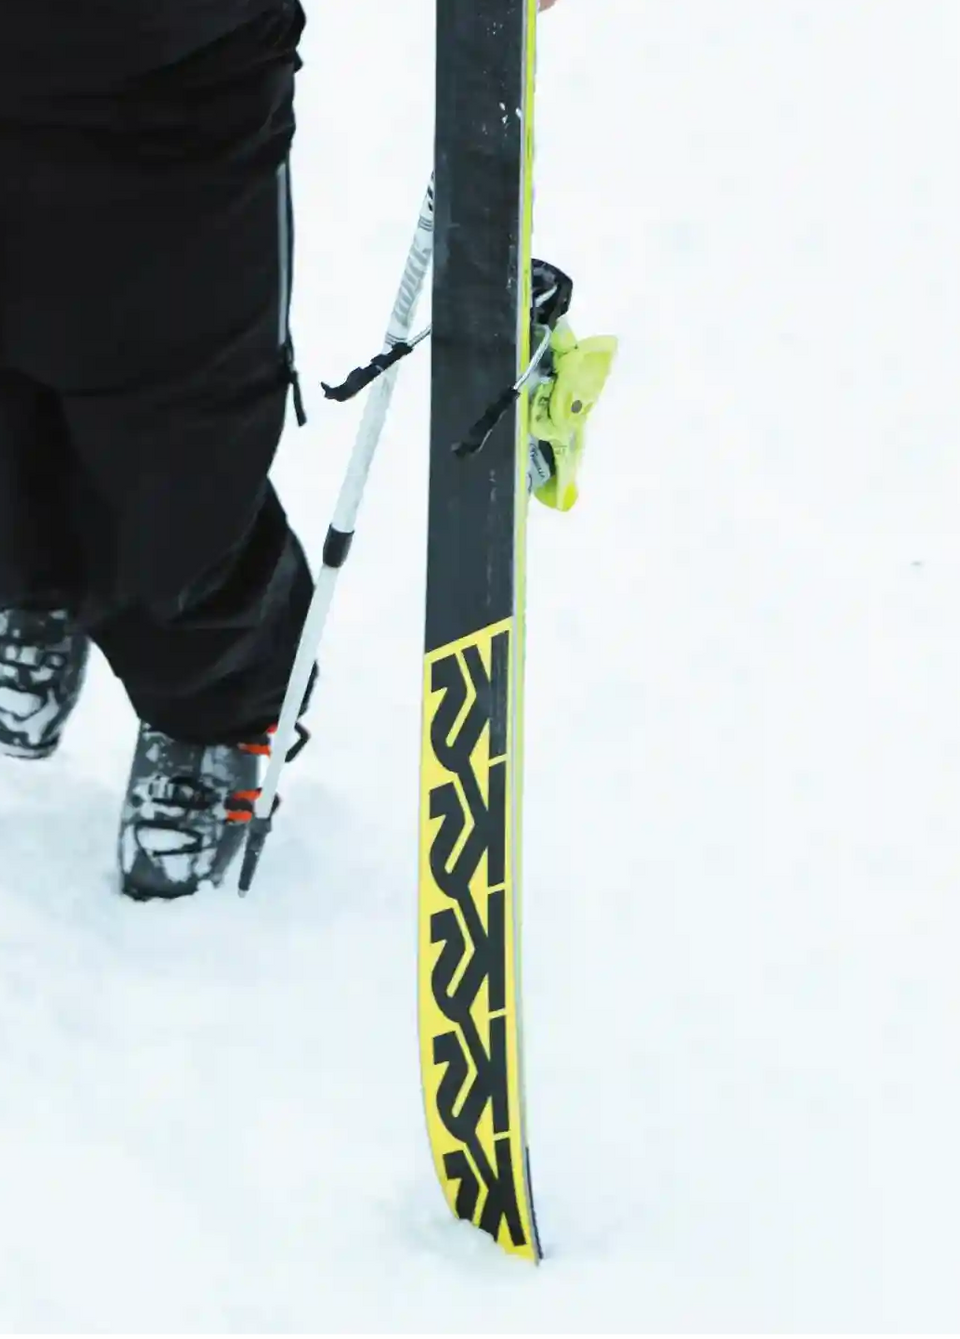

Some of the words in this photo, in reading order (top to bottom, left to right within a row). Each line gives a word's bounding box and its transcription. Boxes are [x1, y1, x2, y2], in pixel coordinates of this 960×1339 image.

[430, 630, 509, 773] K2
[429, 761, 506, 899] K2
[430, 889, 506, 1022] K2
[432, 1015, 509, 1142] K2
